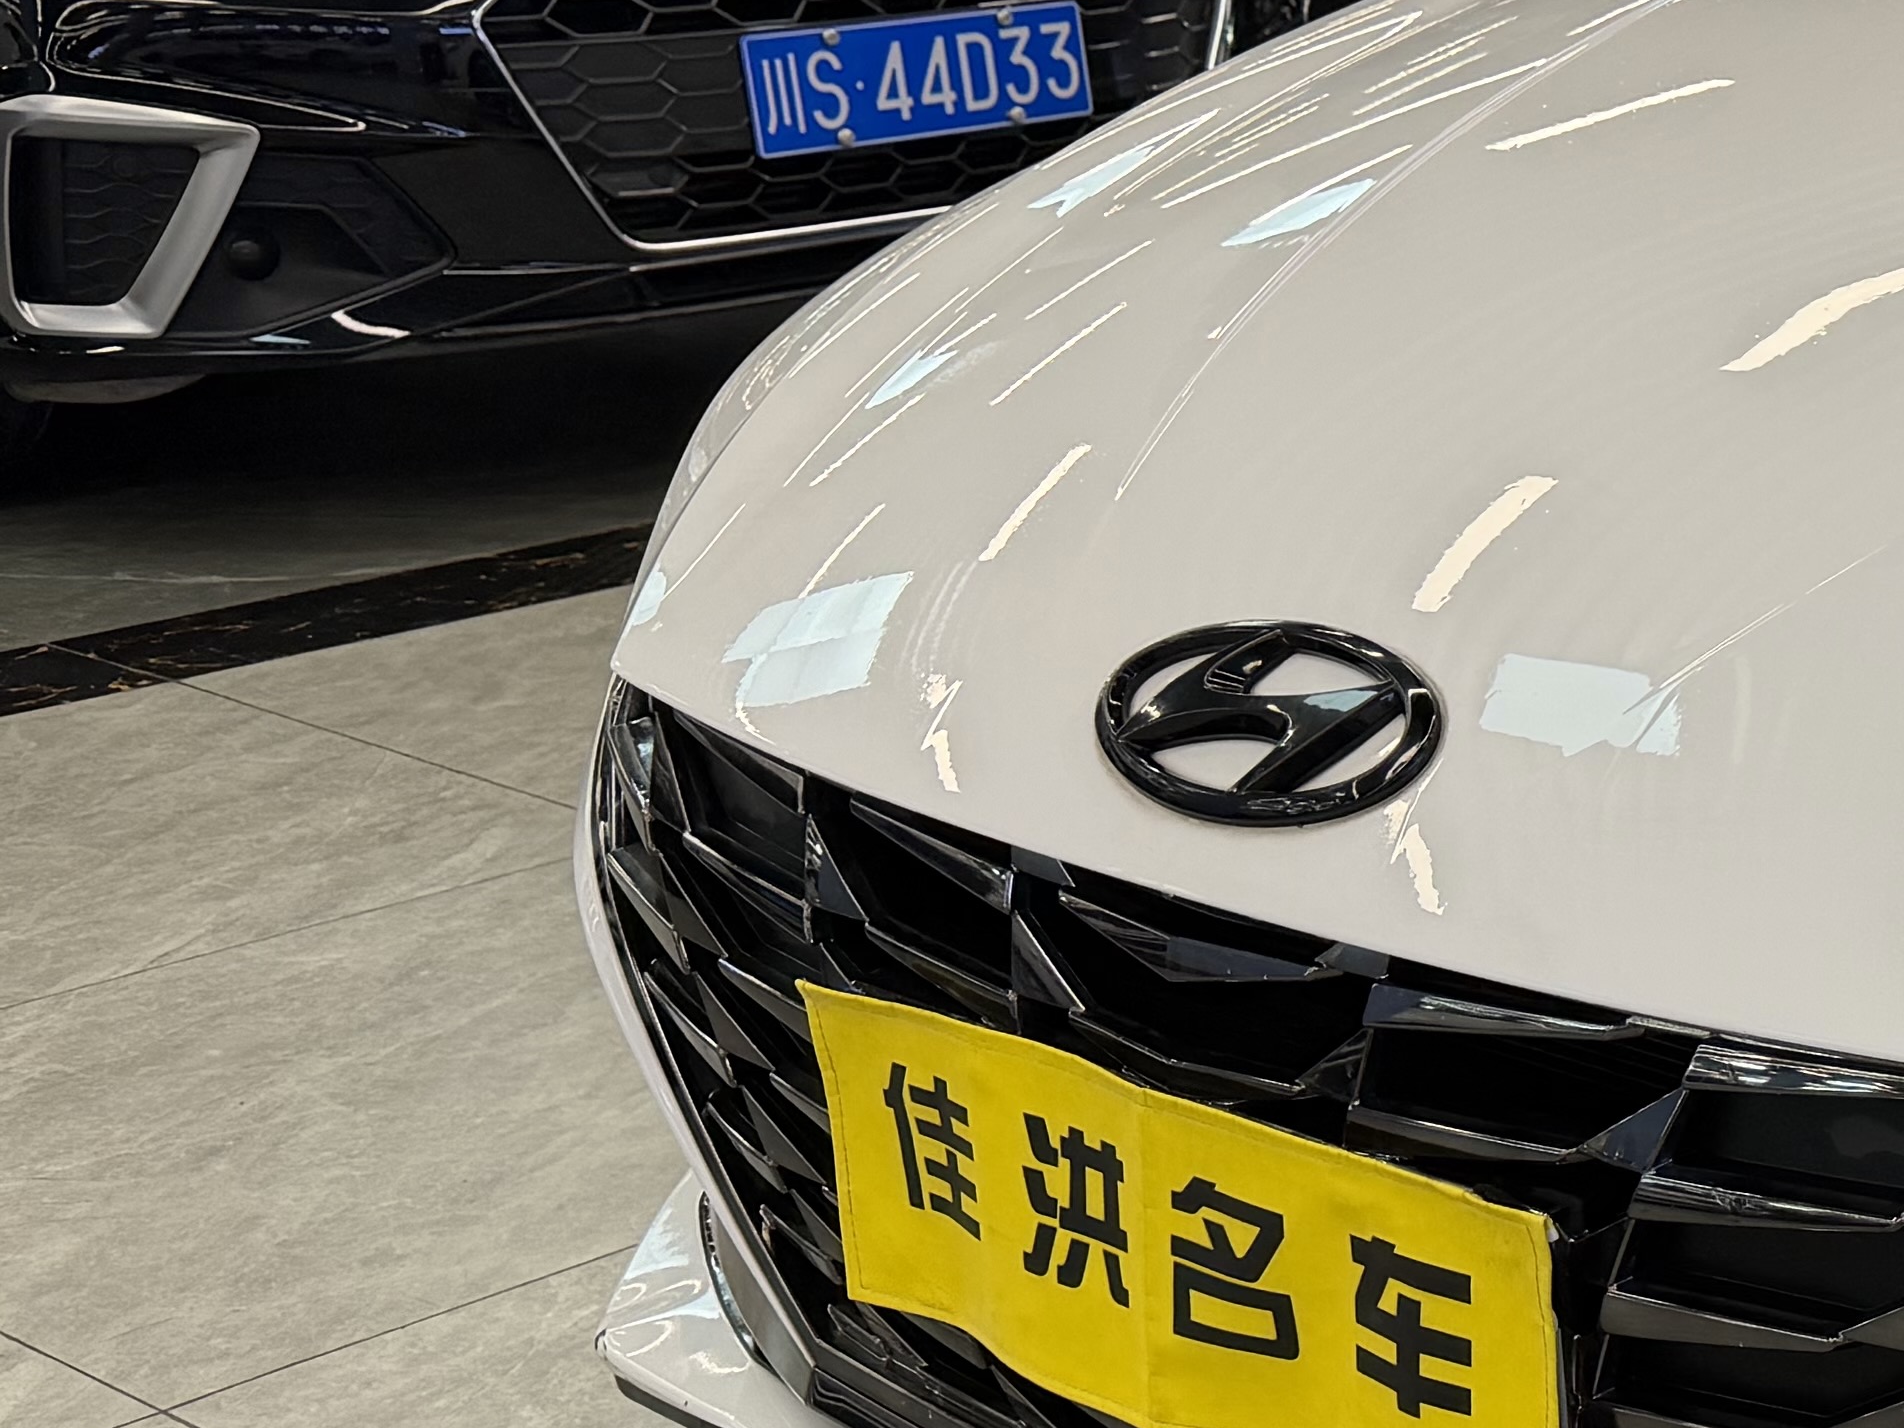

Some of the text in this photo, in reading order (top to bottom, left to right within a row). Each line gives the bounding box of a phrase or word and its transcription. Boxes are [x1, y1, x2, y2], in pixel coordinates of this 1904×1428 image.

[761, 20, 1081, 135] 川S·44D33
[883, 1060, 1474, 1420] 佳洪名车
